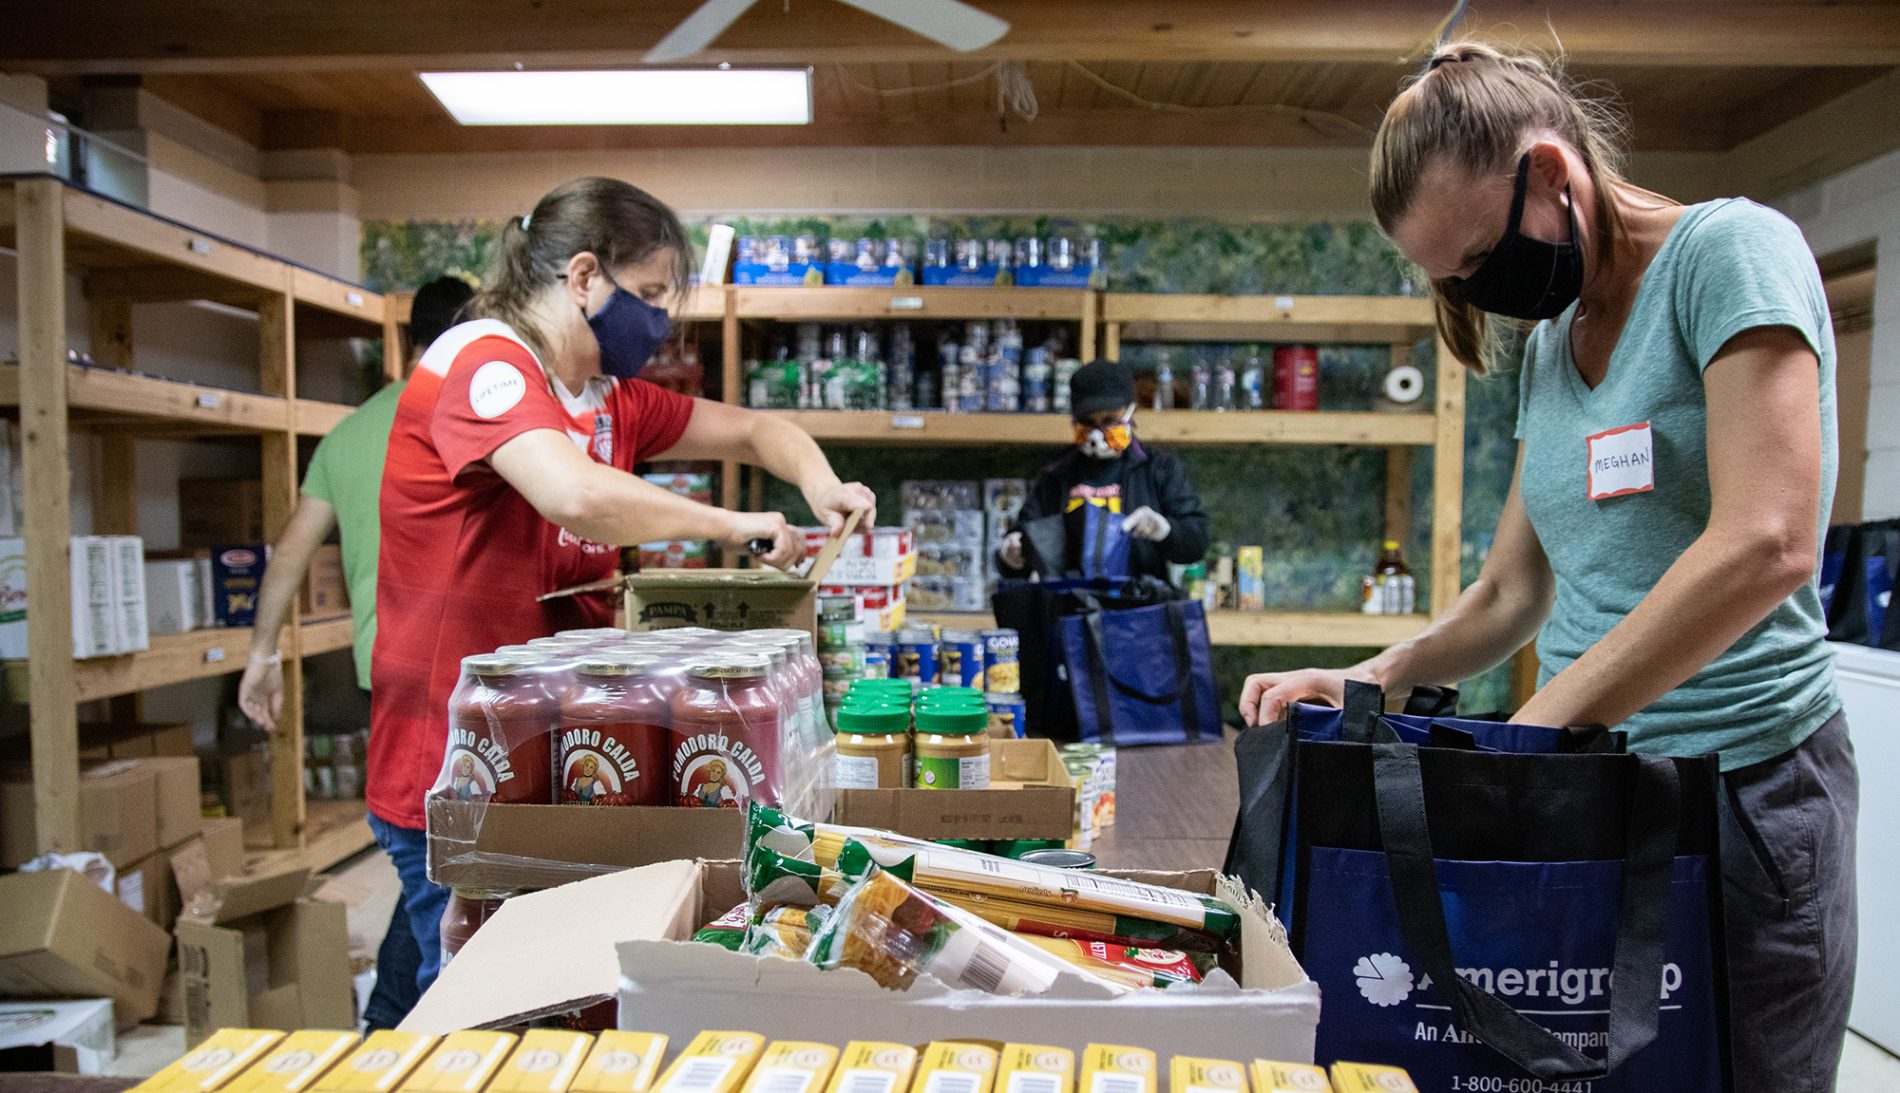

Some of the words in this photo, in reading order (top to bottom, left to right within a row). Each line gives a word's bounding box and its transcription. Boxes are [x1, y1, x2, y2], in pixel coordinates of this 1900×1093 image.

[1594, 446, 1650, 474] MEGHAN
[477, 737, 515, 783] CALDA
[602, 736, 640, 782] CALDA
[731, 740, 766, 785] CALDA
[1417, 960, 1682, 1005] merigrp
[1414, 1021, 1438, 1042] An
[1451, 1075, 1592, 1093] 1-800-600-4441
